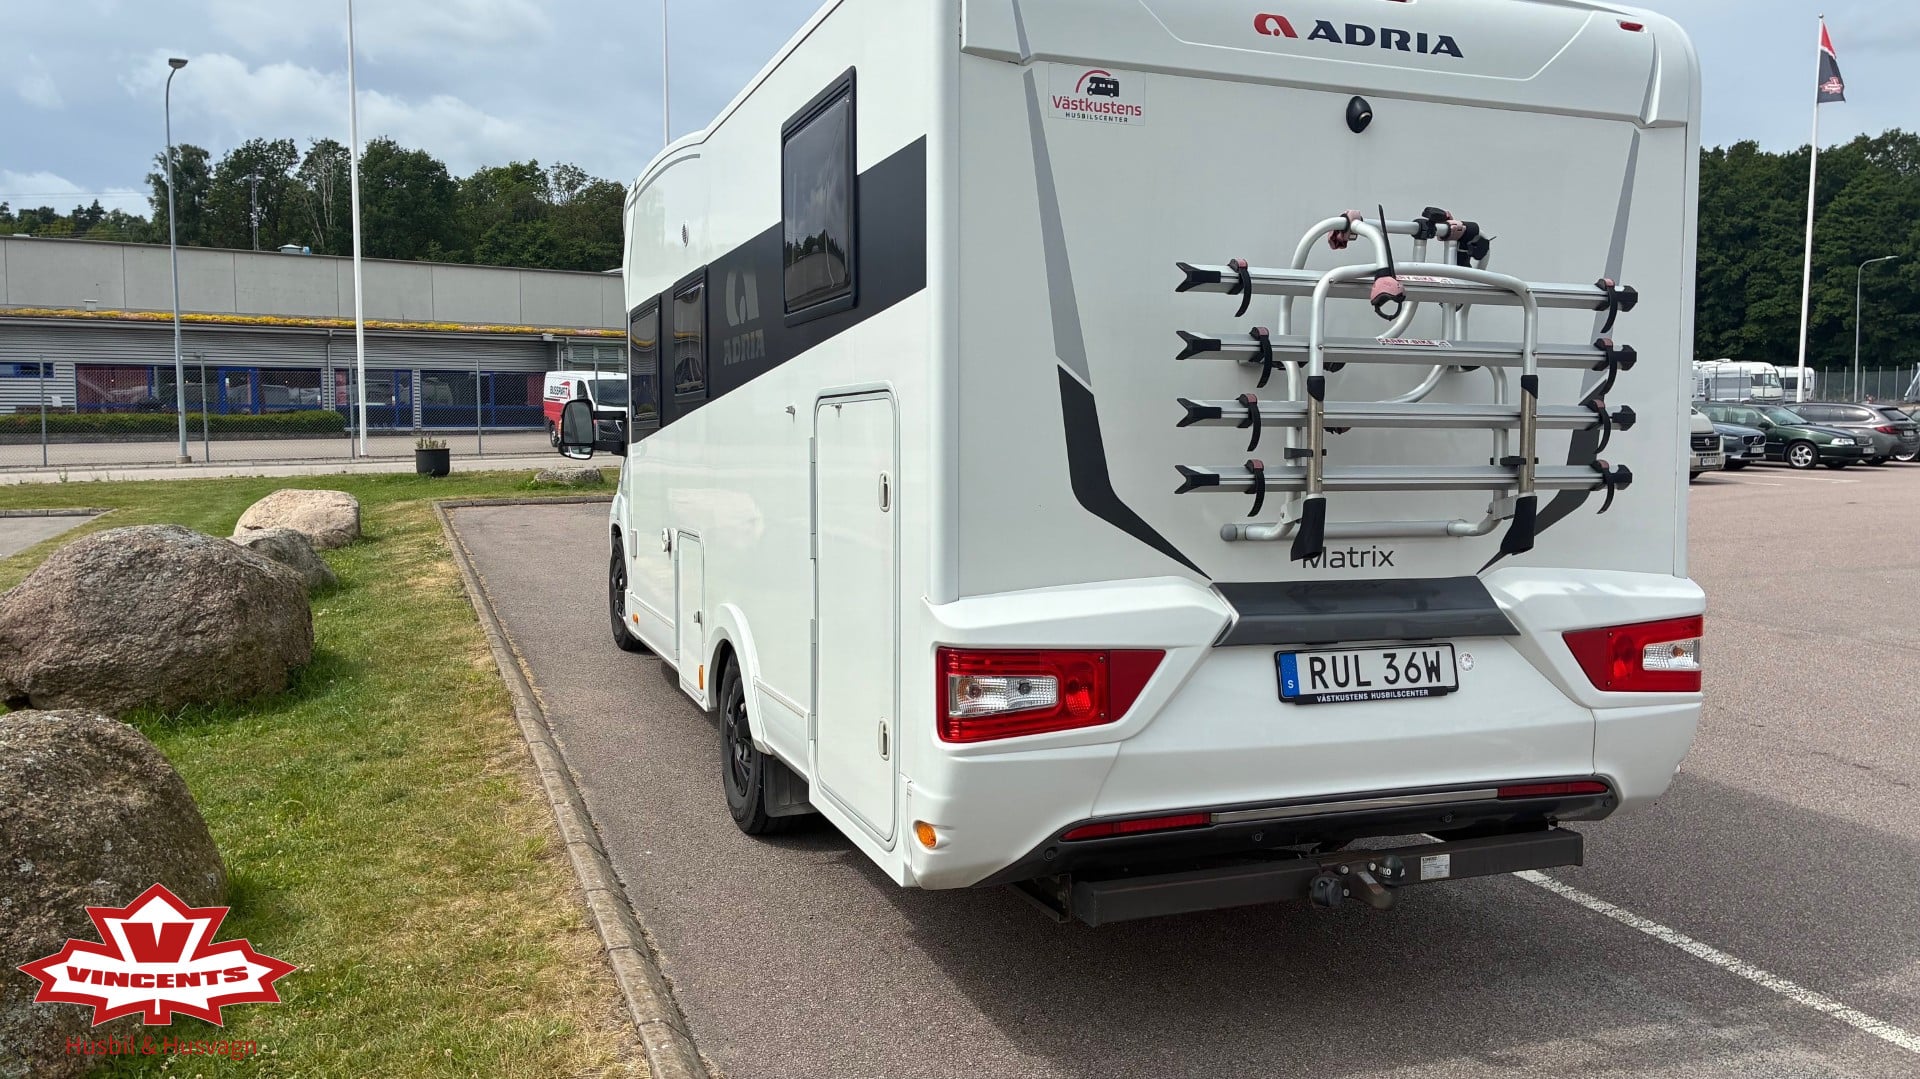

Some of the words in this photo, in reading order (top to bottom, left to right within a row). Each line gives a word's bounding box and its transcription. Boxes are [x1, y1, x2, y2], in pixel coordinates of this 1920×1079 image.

[1307, 19, 1464, 58] ADRIA
[1052, 95, 1142, 116] Västkustens
[1065, 112, 1128, 123] HUSBILSCENTER
[723, 329, 765, 366] ADRIA
[1309, 654, 1372, 690] RUL
[1383, 651, 1441, 685] 36W
[1287, 680, 1295, 689] S
[1370, 688, 1430, 700] HUSBILSCENTER
